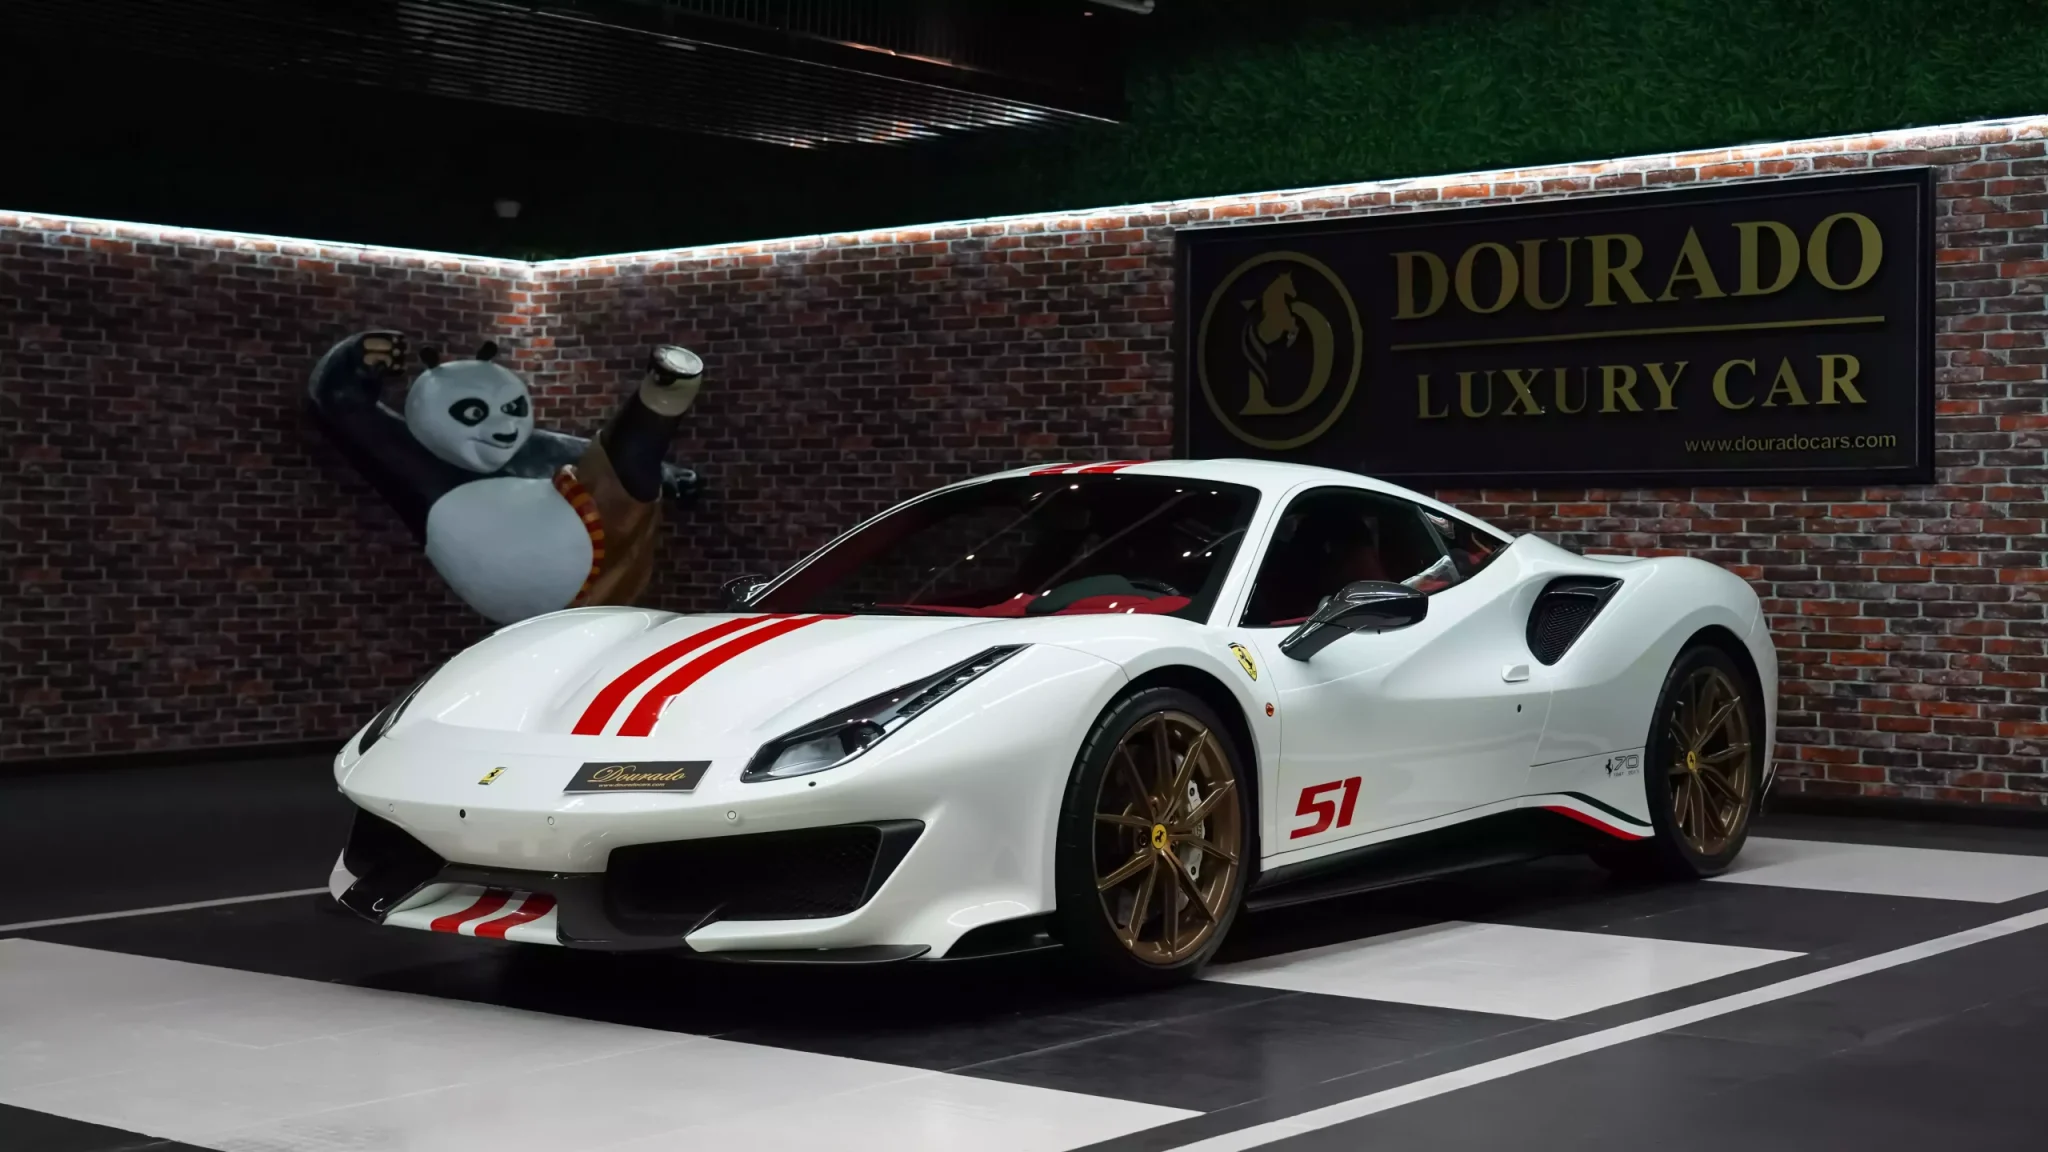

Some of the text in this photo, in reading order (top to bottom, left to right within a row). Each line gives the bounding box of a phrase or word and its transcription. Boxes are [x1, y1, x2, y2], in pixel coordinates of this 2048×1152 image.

[1389, 212, 1883, 320] DOURADO
[1416, 353, 1868, 419] LUXURY CAR
[1684, 433, 1897, 452] www.douradocars.com
[587, 764, 687, 783] Dourado
[1289, 775, 1363, 840] 51
